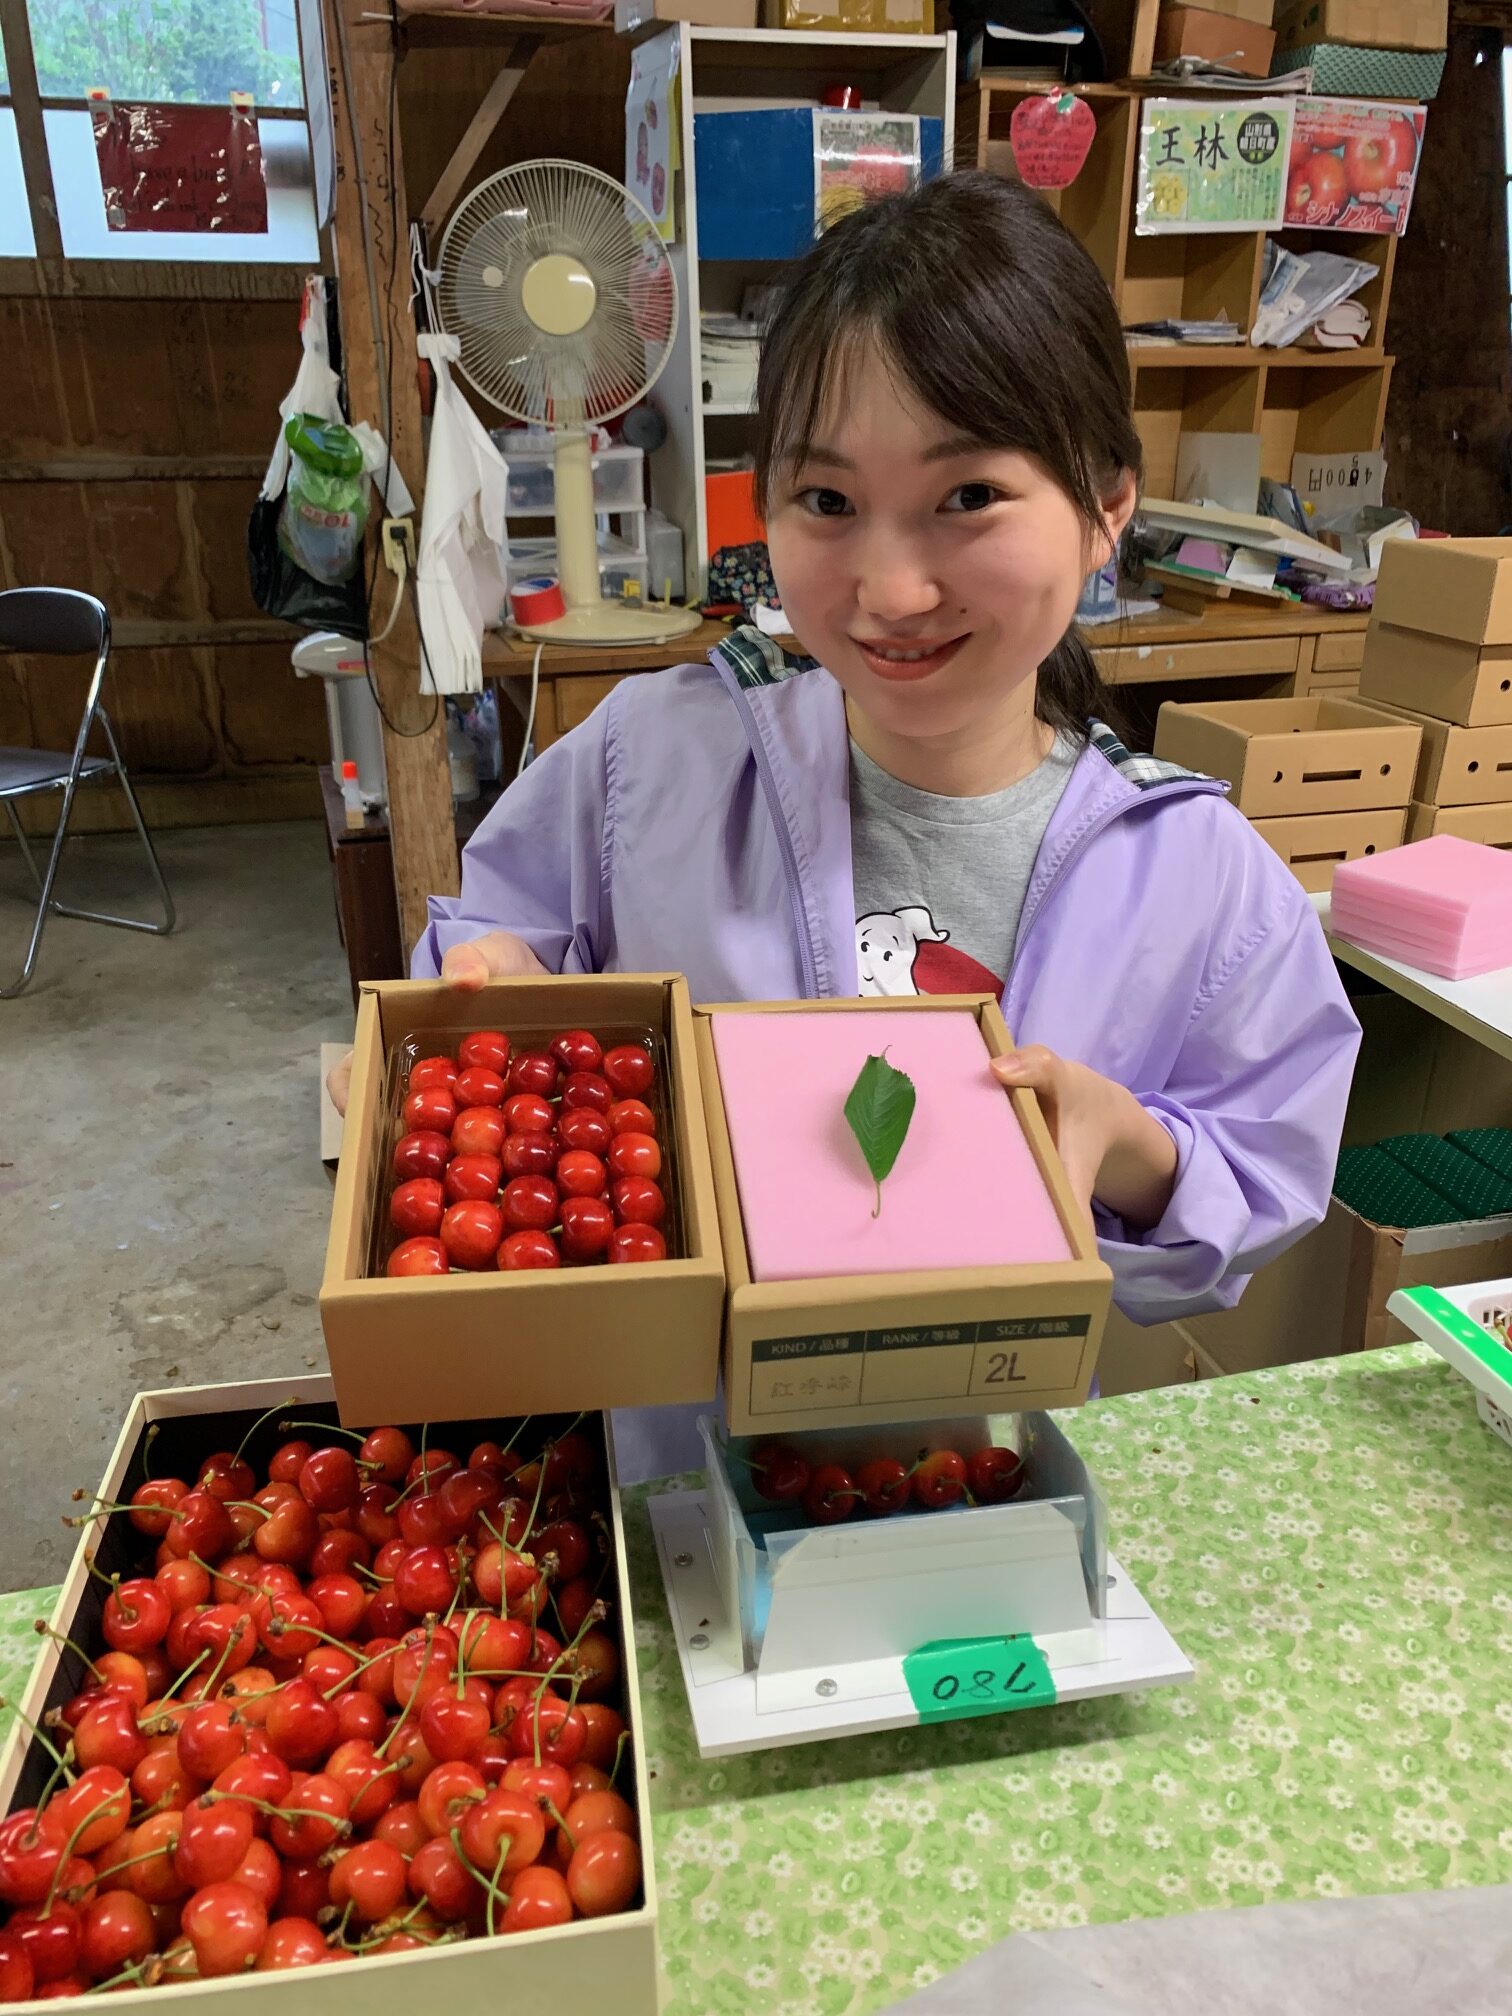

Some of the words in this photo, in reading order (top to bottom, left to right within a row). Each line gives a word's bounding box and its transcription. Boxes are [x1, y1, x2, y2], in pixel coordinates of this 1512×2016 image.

[1155, 121, 1230, 171] 王林
[996, 1323, 1027, 1336] SIZE
[771, 1342, 806, 1355] KIND
[819, 1337, 849, 1351] 品種
[882, 1333, 920, 1345] RANK
[984, 1351, 1027, 1384] 2L
